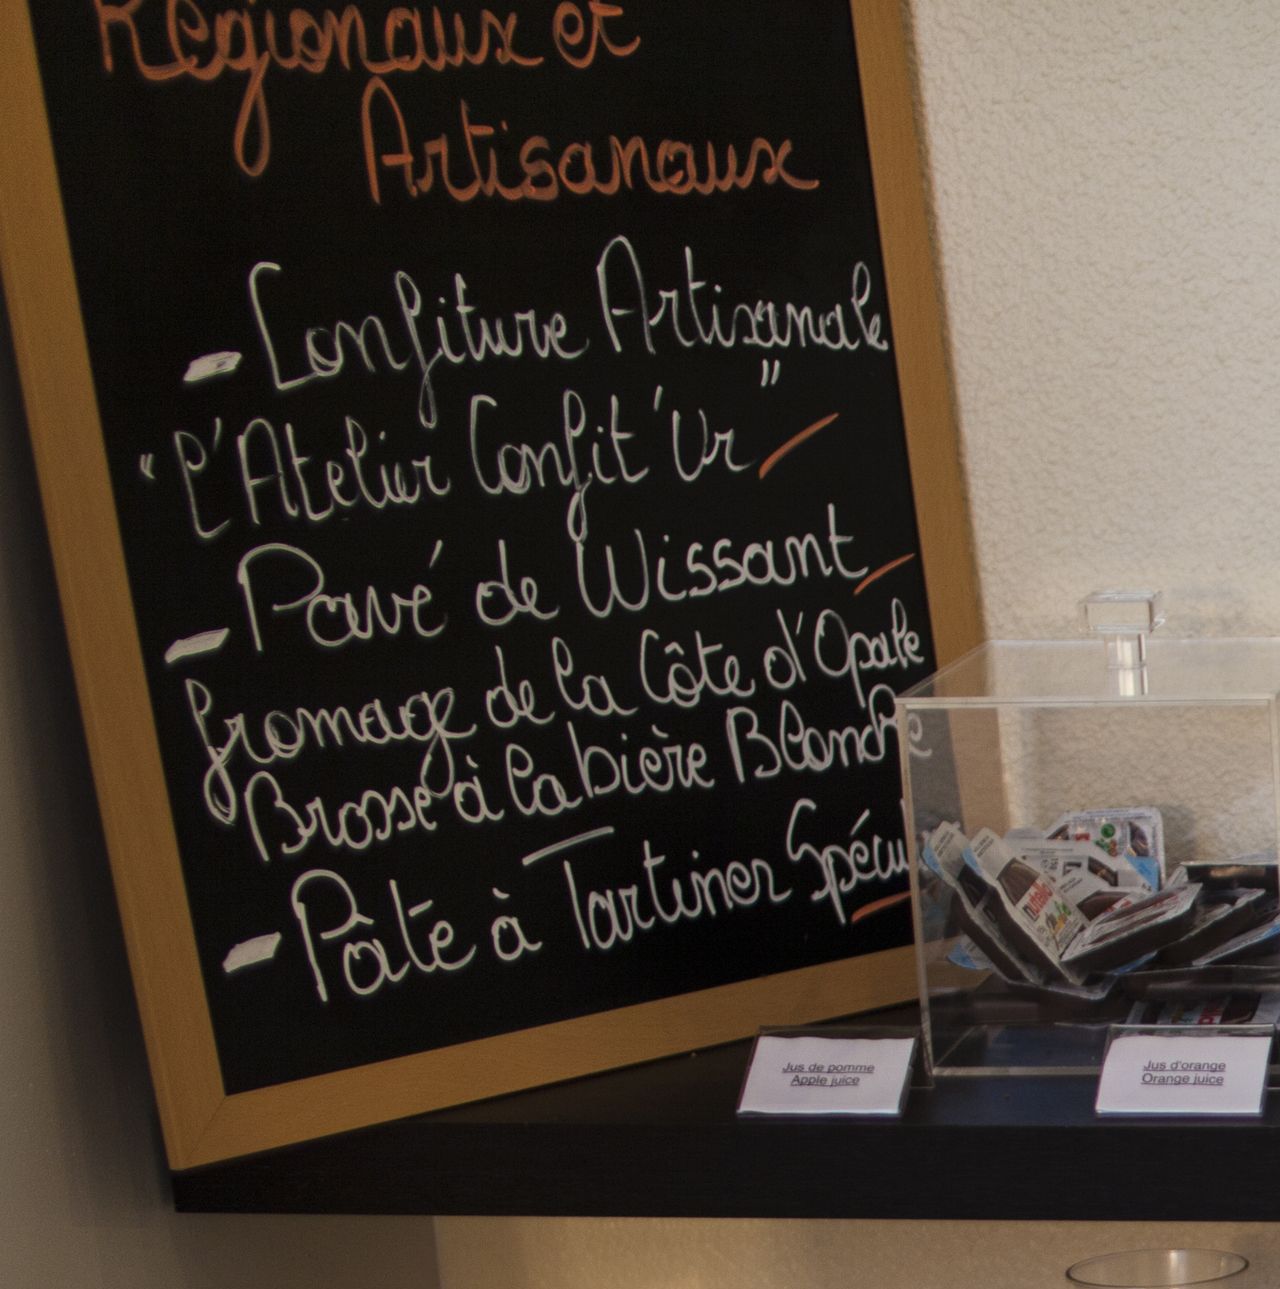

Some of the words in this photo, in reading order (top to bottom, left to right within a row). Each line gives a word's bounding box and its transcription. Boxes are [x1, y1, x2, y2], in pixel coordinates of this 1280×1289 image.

[553, 0, 641, 69] et
[361, 76, 819, 204] Artisanaux
[248, 262, 590, 428] Confiture
[238, 540, 444, 652] Pavé
[475, 540, 559, 624] de
[576, 503, 869, 619] Wissant
[485, 645, 556, 728] de
[551, 637, 639, 716] la
[638, 628, 756, 708] Côte
[504, 743, 583, 816] la
[490, 886, 543, 961] à
[782, 1062, 805, 1073] Jus
[808, 1062, 824, 1073] de
[827, 1064, 875, 1074] pomme
[790, 1075, 827, 1086] Apple
[830, 1075, 860, 1087] juice
[1141, 1073, 1190, 1085] Orange
[1193, 1073, 1224, 1085] juice
[1143, 1060, 1166, 1071] Jus
[1170, 1060, 1226, 1073] d'orange
